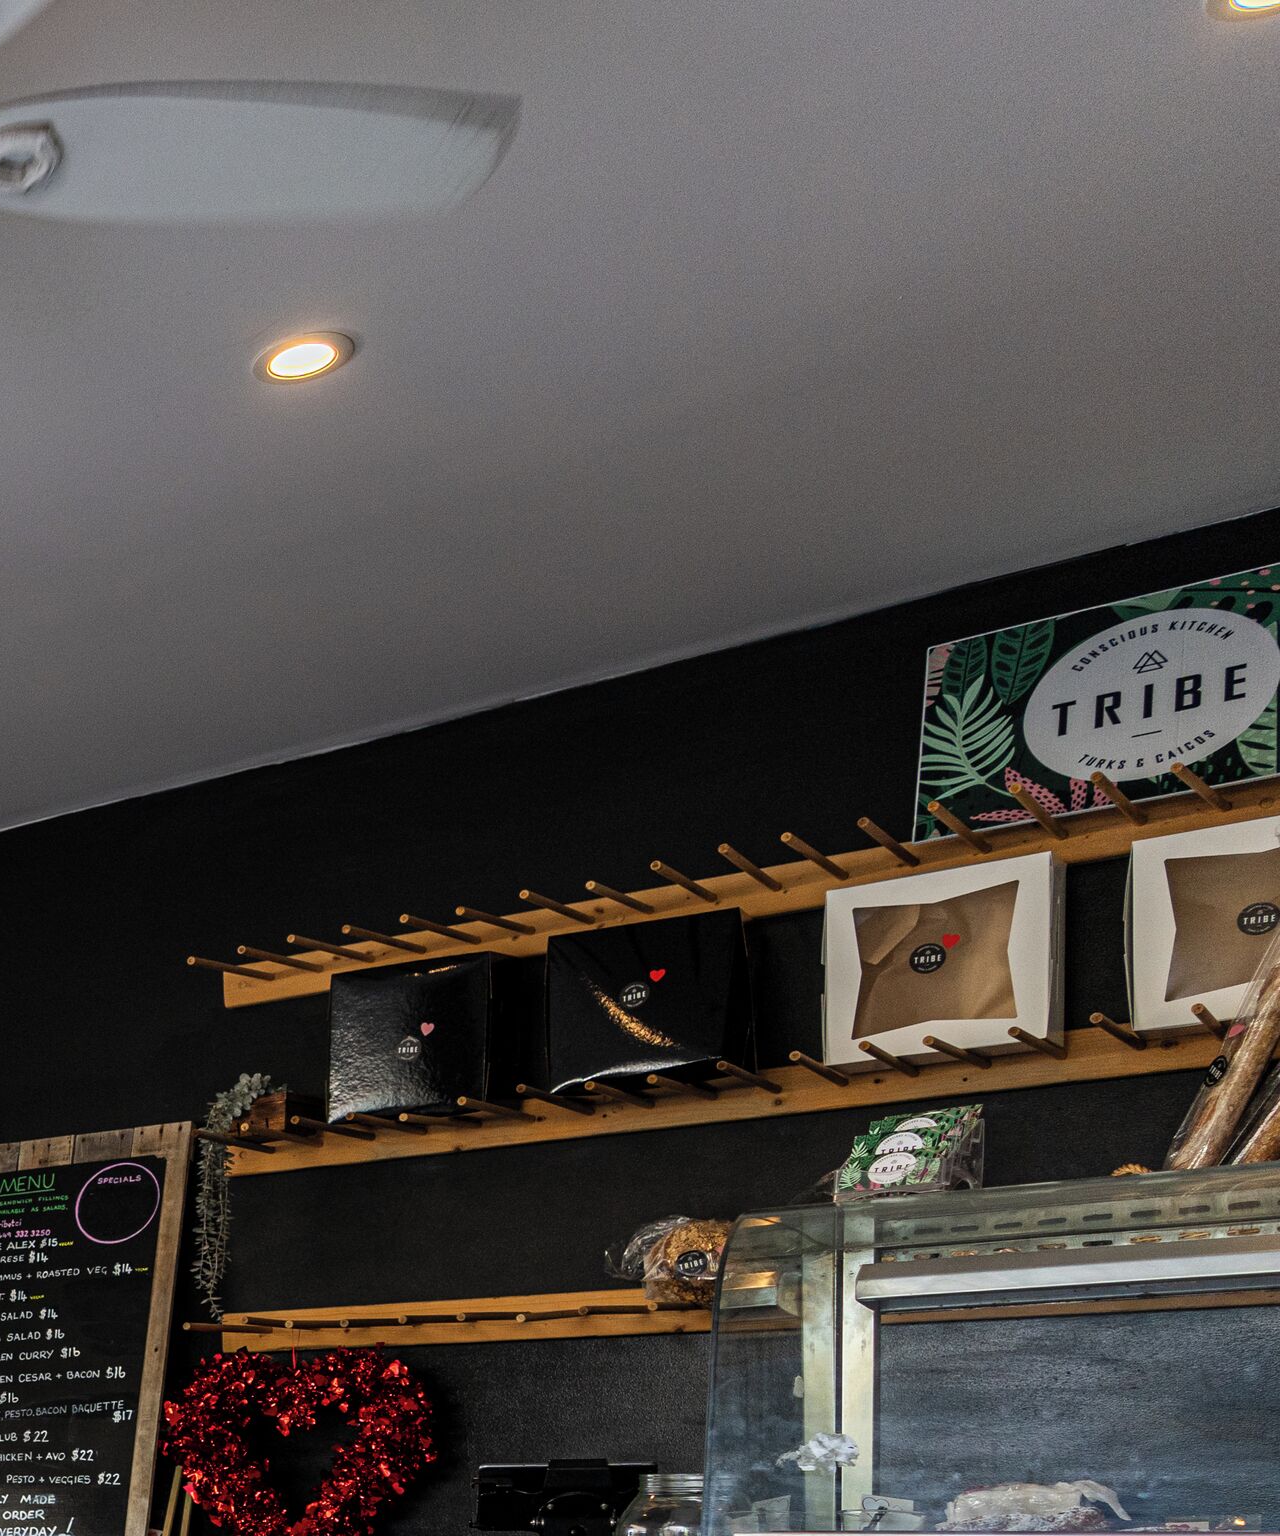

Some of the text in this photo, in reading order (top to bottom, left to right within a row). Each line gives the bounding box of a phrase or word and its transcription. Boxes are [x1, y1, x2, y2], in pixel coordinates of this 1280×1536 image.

[1072, 621, 1234, 672] CONSCIOUS KITCHEN
[1052, 664, 1247, 736] TRIBE
[1078, 755, 1126, 769] TURKS
[1156, 729, 1216, 763] CAICOS
[1243, 914, 1276, 925] TRIBE
[914, 954, 942, 964] TRIBE
[97, 1175, 142, 1185] SPECIALS
[30, 1229, 51, 1237] 3250
[7, 1240, 36, 1250] ALEX
[40, 1238, 58, 1248] $15
[28, 1251, 48, 1263] $14
[36, 1268, 80, 1279] ROASTED
[87, 1266, 107, 1275] VEG
[112, 1263, 133, 1276] $14
[679, 1259, 703, 1270] TRIBE
[10, 1289, 27, 1301] $14
[0, 1310, 33, 1321] SALAD
[39, 1309, 58, 1320] $14
[6, 1331, 41, 1342] SALAD
[46, 1329, 65, 1340] $16
[19, 1350, 54, 1361] CURRY
[60, 1347, 81, 1359] $16
[18, 1373, 52, 1383] CESAR
[66, 1370, 100, 1380] BACON
[106, 1366, 126, 1379] $16
[0, 1392, 19, 1405] $16
[72, 1400, 125, 1414] BAGUETTE
[112, 1410, 133, 1423] $17
[23, 1430, 49, 1443] $22
[45, 1452, 66, 1461] AVO
[71, 1449, 94, 1462] $22
[6, 1474, 35, 1484] PESTO
[49, 1475, 91, 1485] VEGGIES
[97, 1473, 121, 1486] $22
[20, 1495, 56, 1505] MADE
[2, 1510, 45, 1521] ORDER
